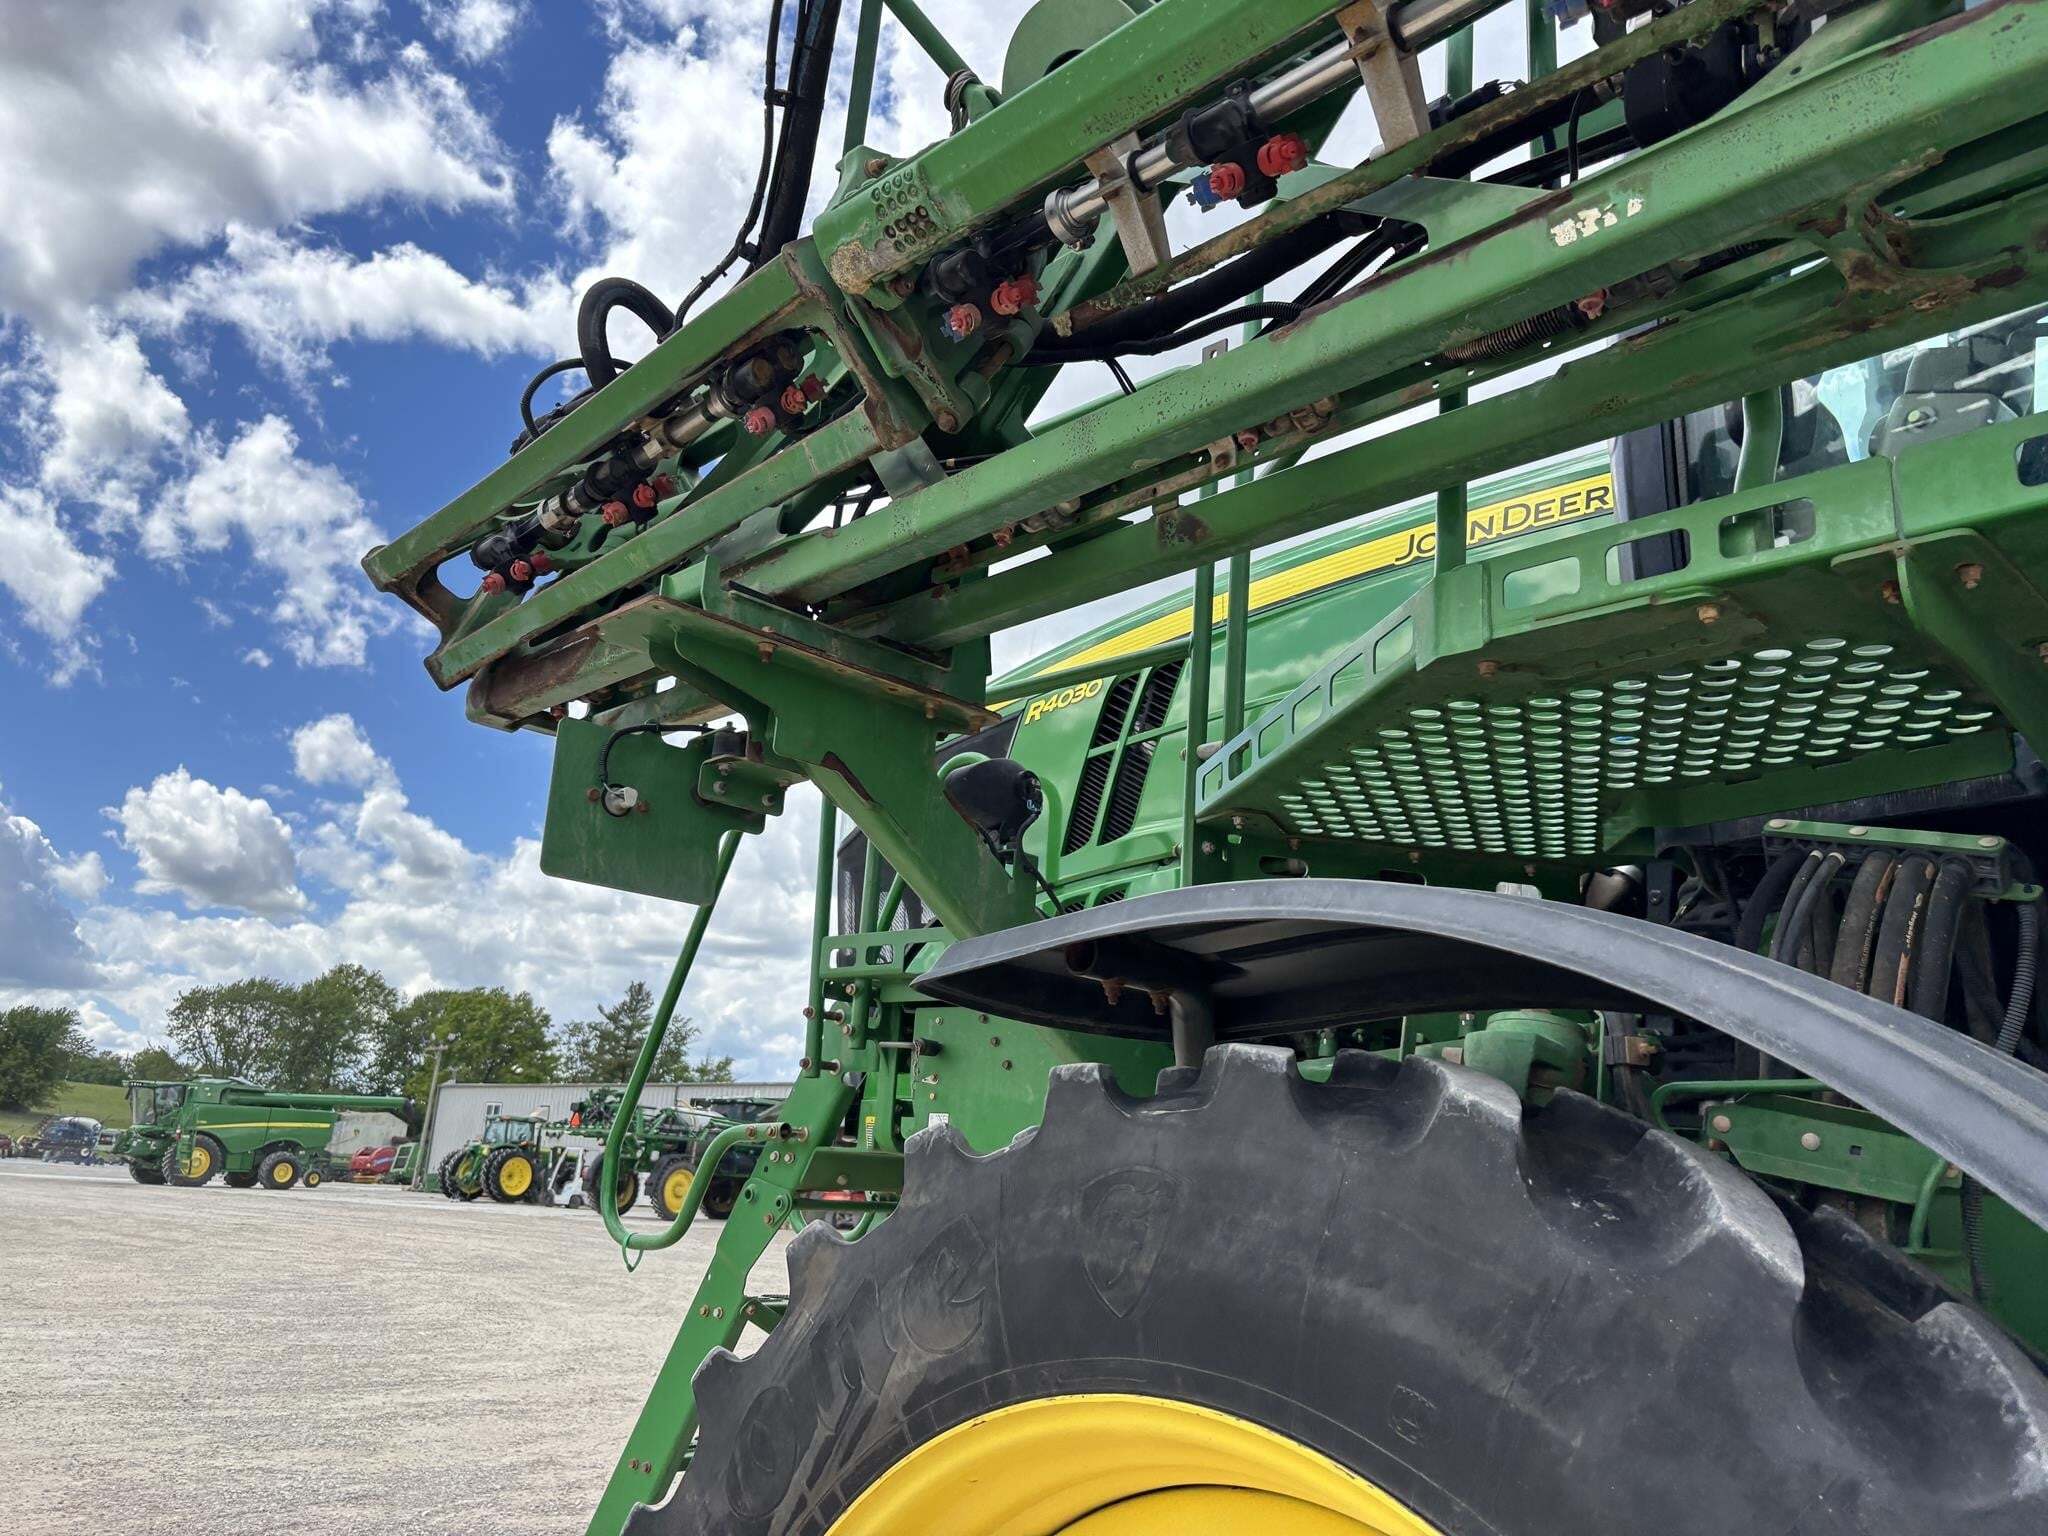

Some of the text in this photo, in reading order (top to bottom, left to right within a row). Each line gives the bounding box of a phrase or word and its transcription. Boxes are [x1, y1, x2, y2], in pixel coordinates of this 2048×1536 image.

[1395, 486, 1610, 562] JON DEER
[1024, 679, 1104, 725] R4030
